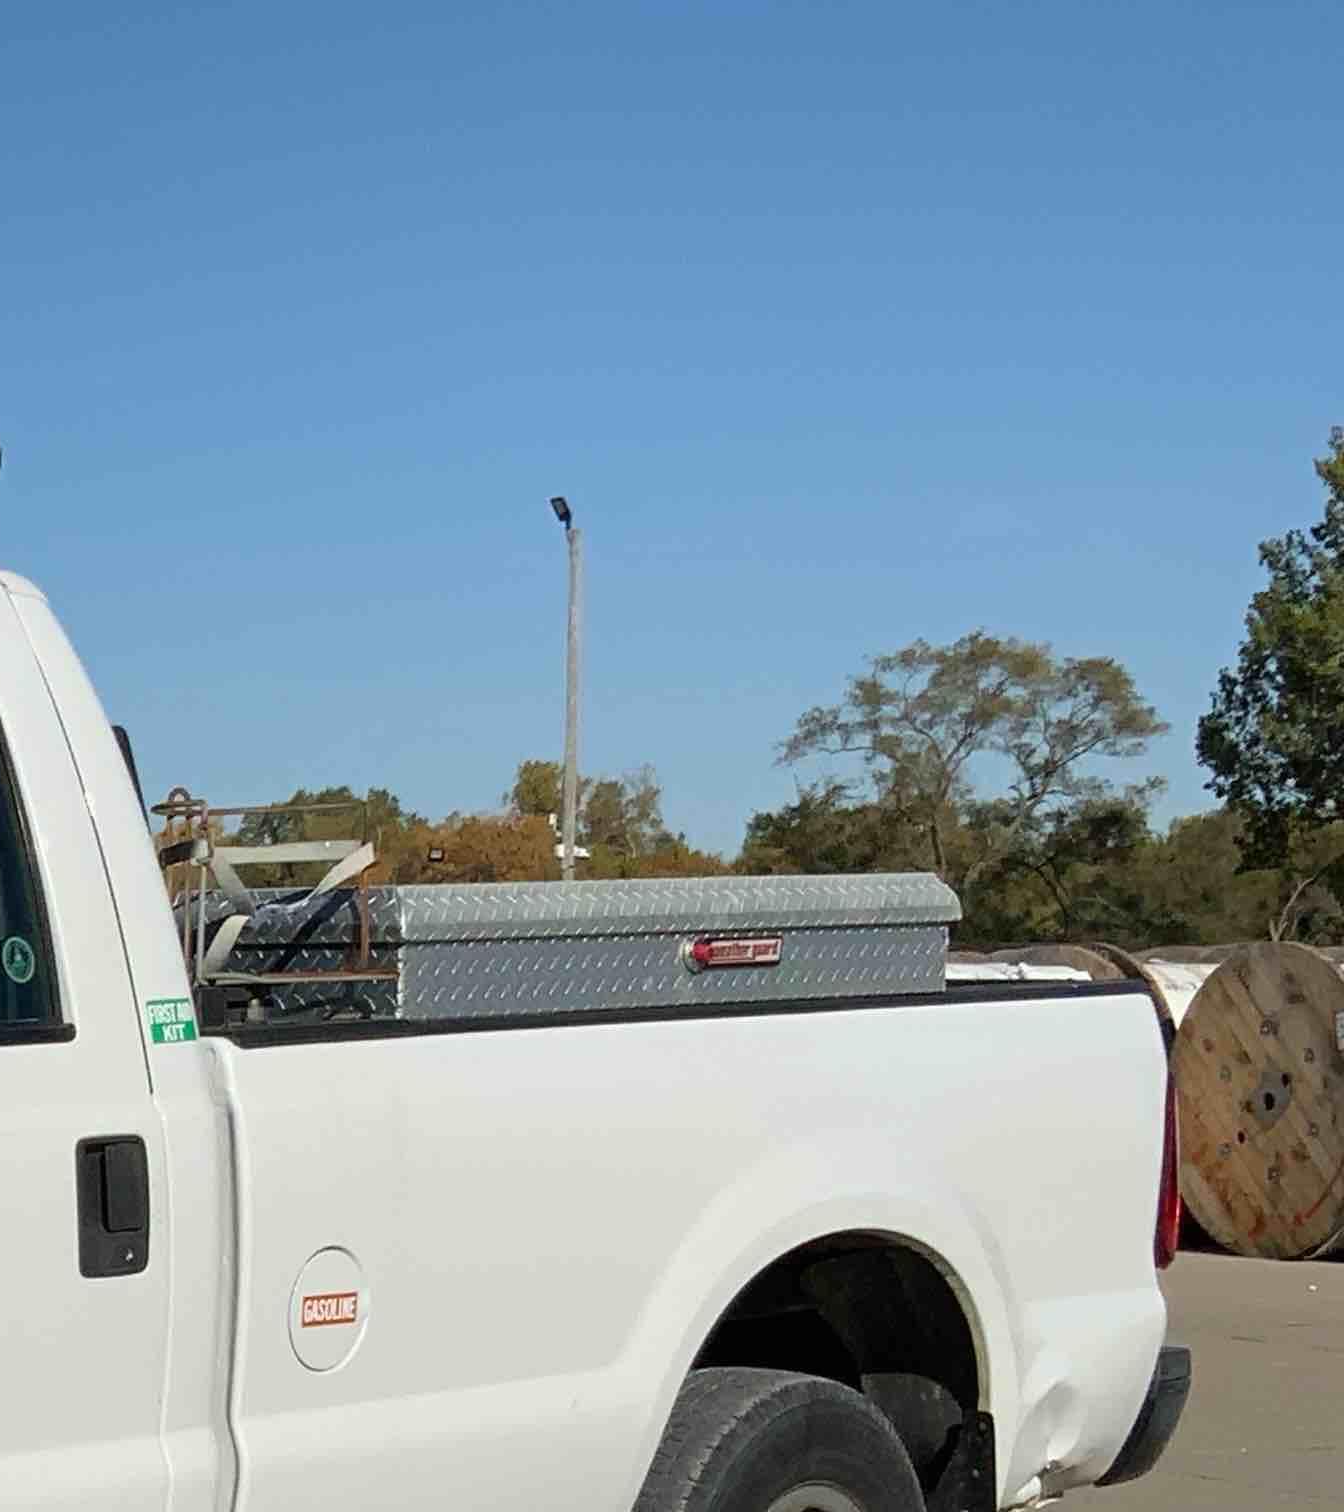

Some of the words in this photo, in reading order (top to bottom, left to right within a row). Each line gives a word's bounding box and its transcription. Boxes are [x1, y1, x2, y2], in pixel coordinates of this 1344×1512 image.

[147, 1003, 177, 1024] FIRST
[161, 1023, 185, 1041] KIT
[303, 1297, 357, 1323] GASOLINE
